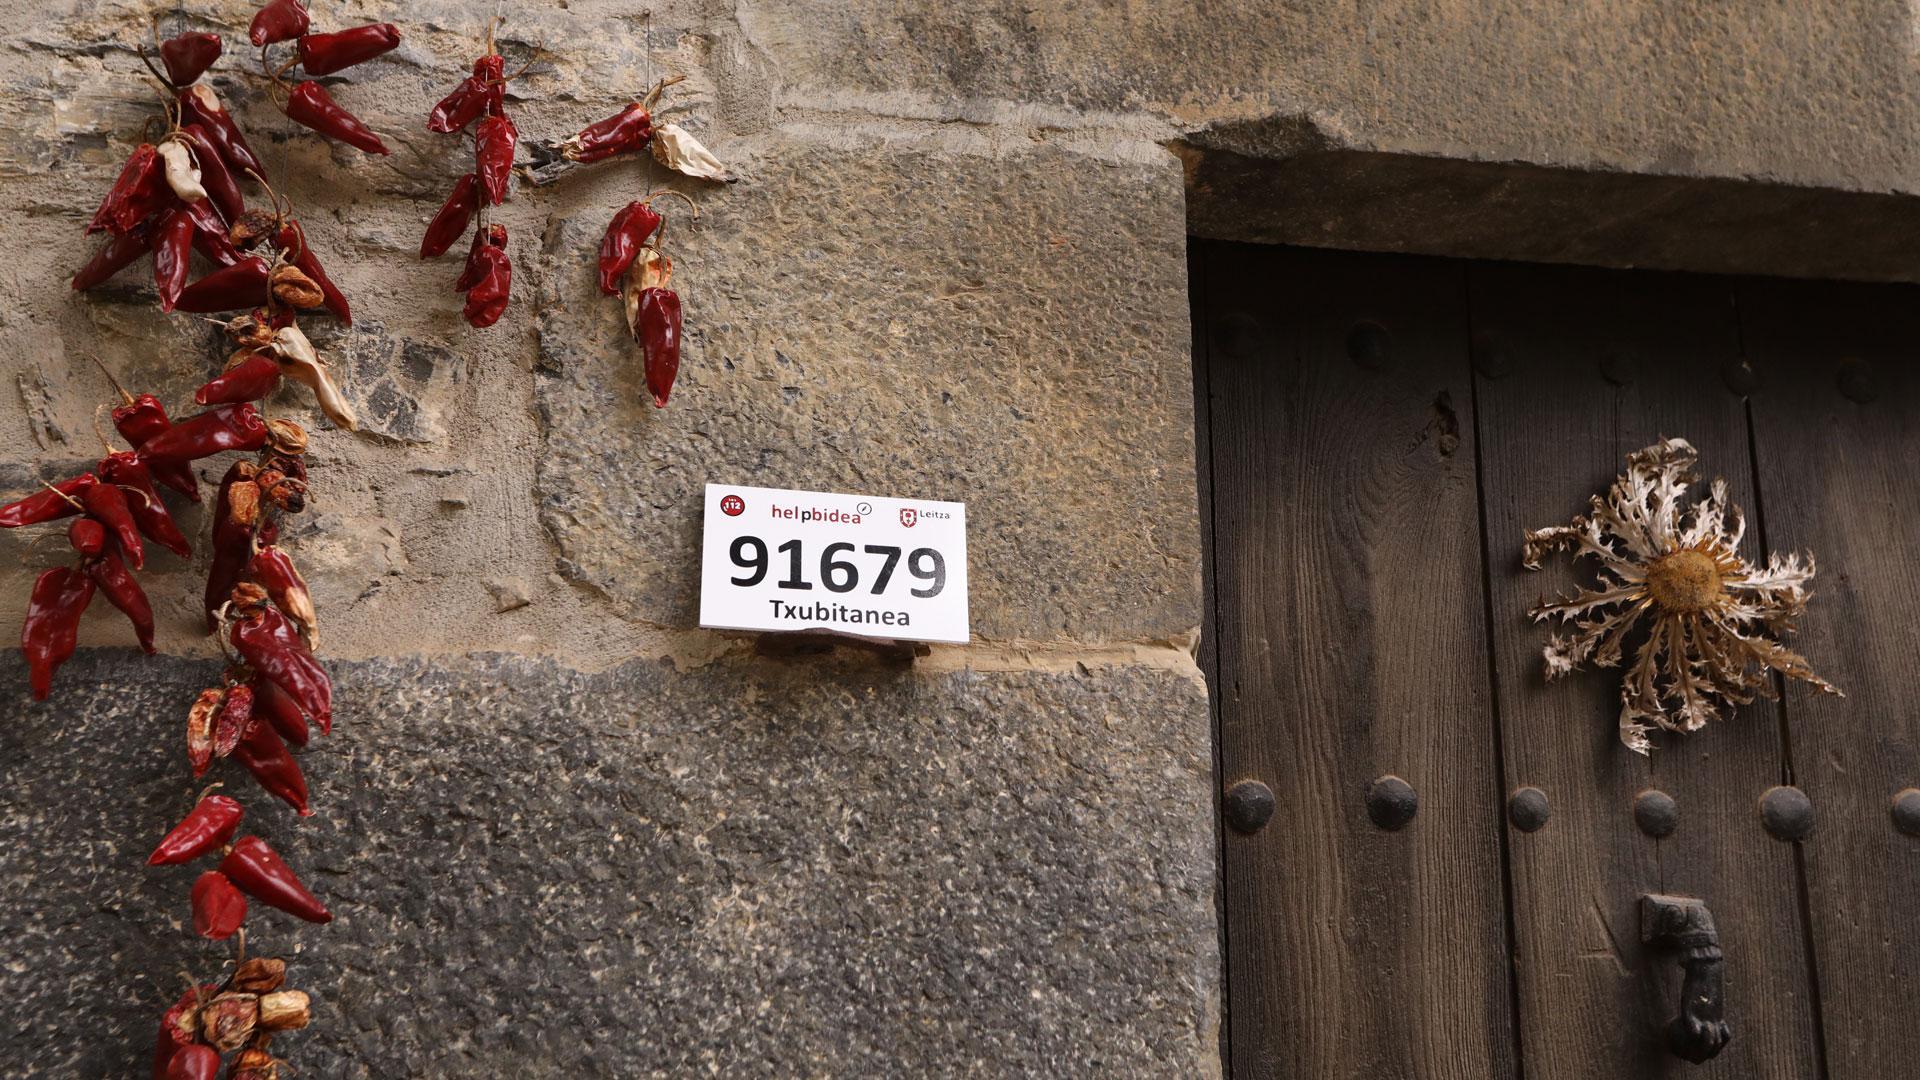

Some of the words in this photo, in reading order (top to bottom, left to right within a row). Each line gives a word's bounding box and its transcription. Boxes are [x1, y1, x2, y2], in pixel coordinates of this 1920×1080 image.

[724, 501, 741, 511] 112
[772, 504, 861, 524] helpbidea
[920, 510, 951, 520] Leitza
[729, 535, 947, 598] 91679
[769, 599, 910, 626] Txubitanea
